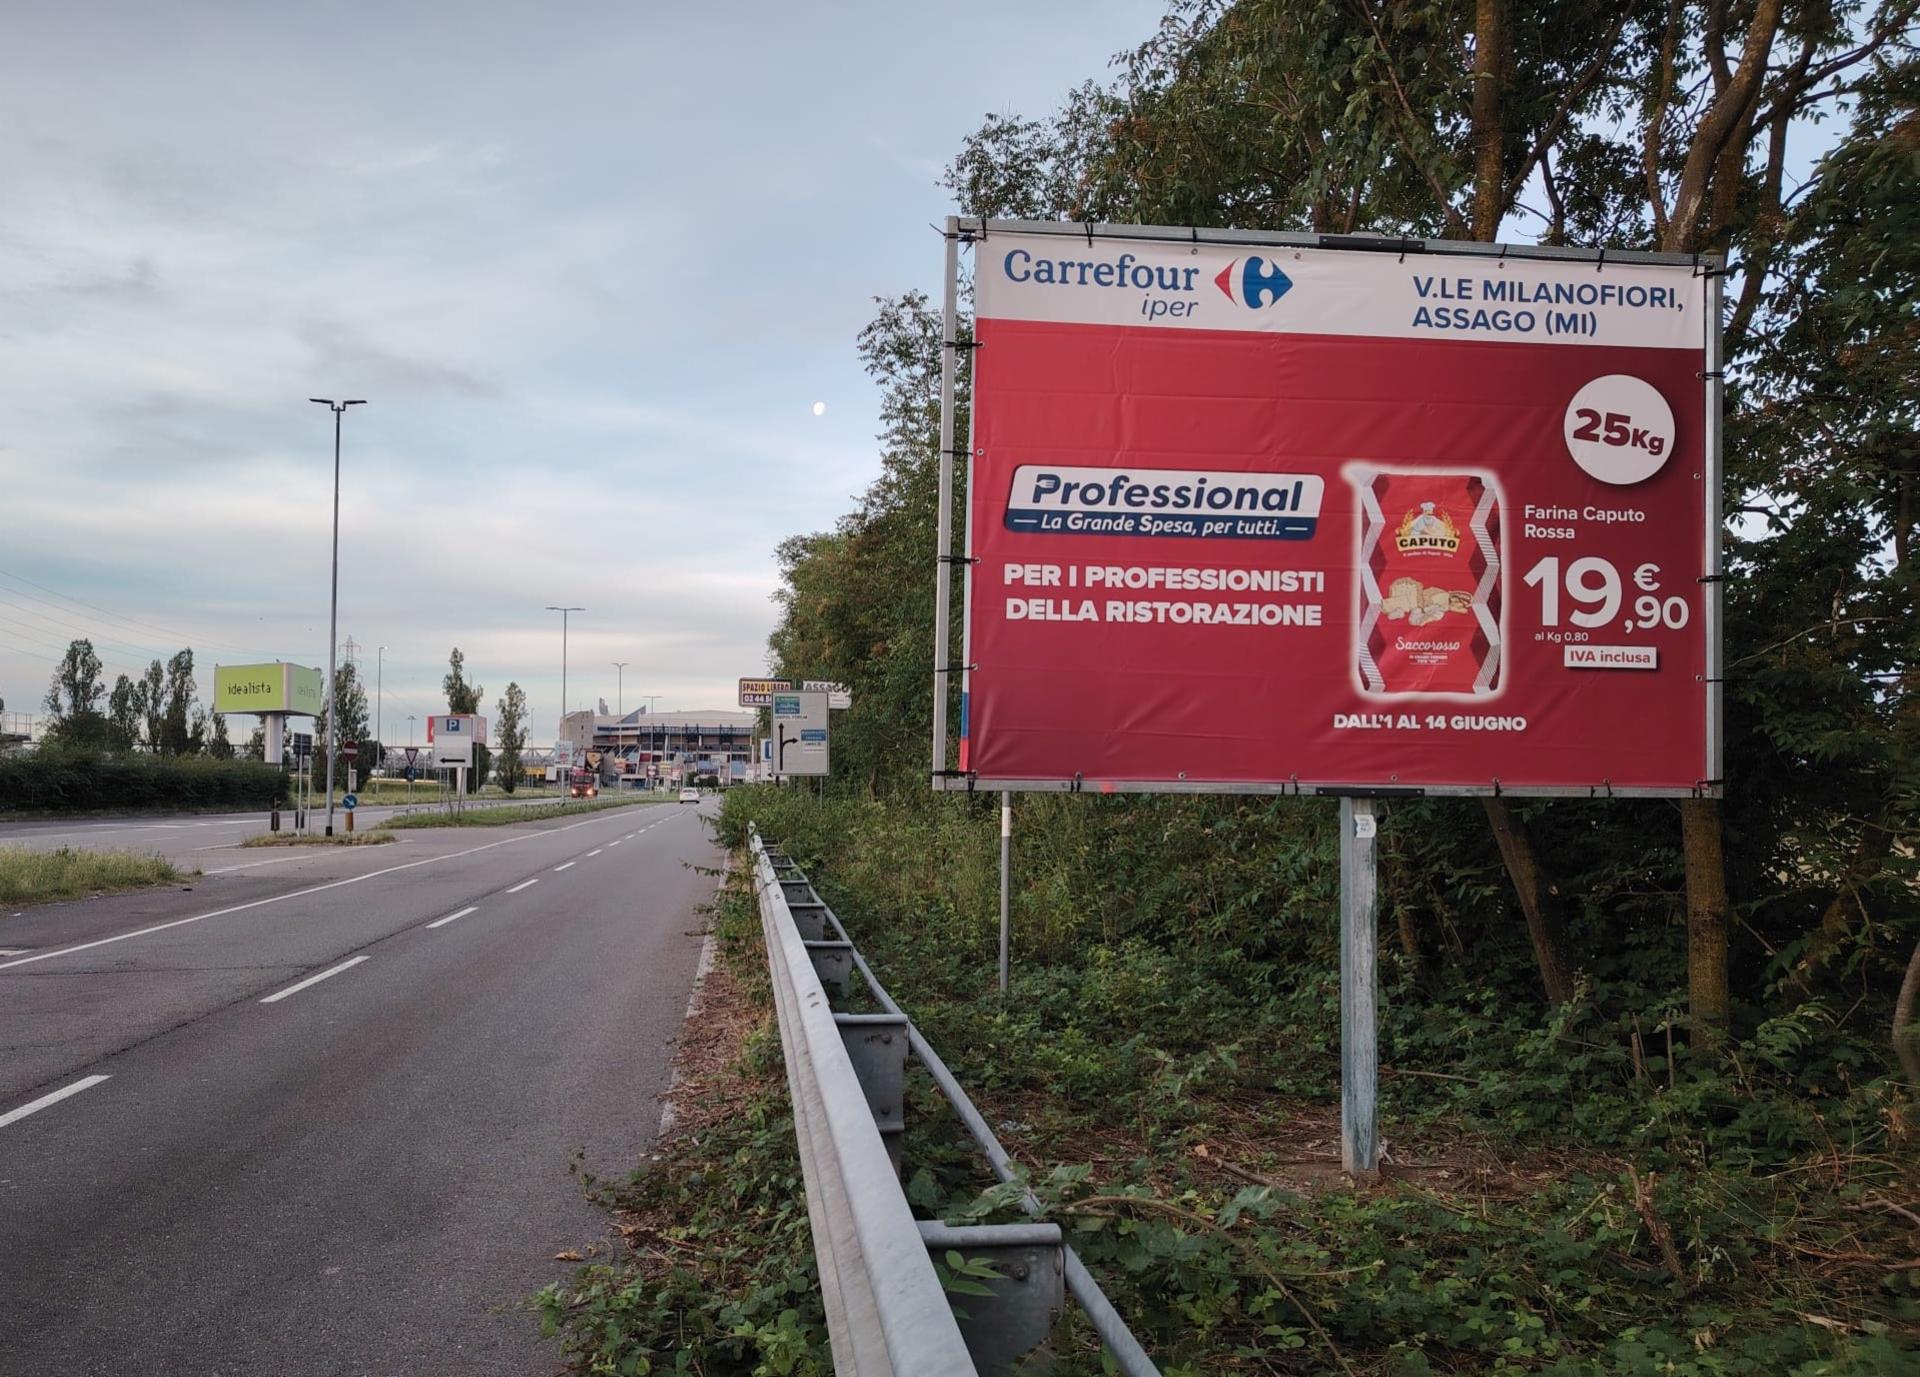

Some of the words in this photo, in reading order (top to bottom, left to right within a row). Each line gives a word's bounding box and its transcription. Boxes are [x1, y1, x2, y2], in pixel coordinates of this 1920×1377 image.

[1004, 249, 1199, 291] Carrefour
[1412, 276, 1473, 300] V.LE
[1483, 279, 1684, 312] MILANOFIORI,
[1141, 293, 1199, 321] iper
[1412, 306, 1536, 333] ASSAGO
[1545, 310, 1597, 337] (MI)
[1032, 474, 1303, 512] Professional
[1525, 504, 1578, 520] Farina
[1583, 506, 1645, 524] Caputo
[1041, 514, 1060, 530] La
[1067, 513, 1135, 532] Grande
[1139, 514, 1198, 536] Spesa,
[1201, 520, 1234, 537] per
[1236, 520, 1281, 536] tutti.
[1525, 524, 1575, 539] Rossa
[1399, 538, 1456, 549] CAPUTO
[1004, 564, 1061, 587] PER
[1069, 566, 1077, 587] I
[1085, 566, 1325, 593] PROFESSIONISTI
[1006, 598, 1099, 622] DELLA
[1106, 600, 1323, 626] RISTORAZIONE
[1395, 636, 1461, 651] Saccorosso
[1534, 632, 1545, 641] al
[1547, 632, 1561, 643] Kg
[1564, 632, 1589, 642] 0,80
[1570, 650, 1596, 662] IVA
[1600, 651, 1651, 664] inclusa
[228, 680, 271, 696] idealista
[743, 682, 765, 692] SPAZIO
[806, 683, 848, 693] ASSAGO
[1396, 714, 1421, 729] AL
[1425, 715, 1447, 730] 14
[1451, 716, 1527, 731] GIUGNO
